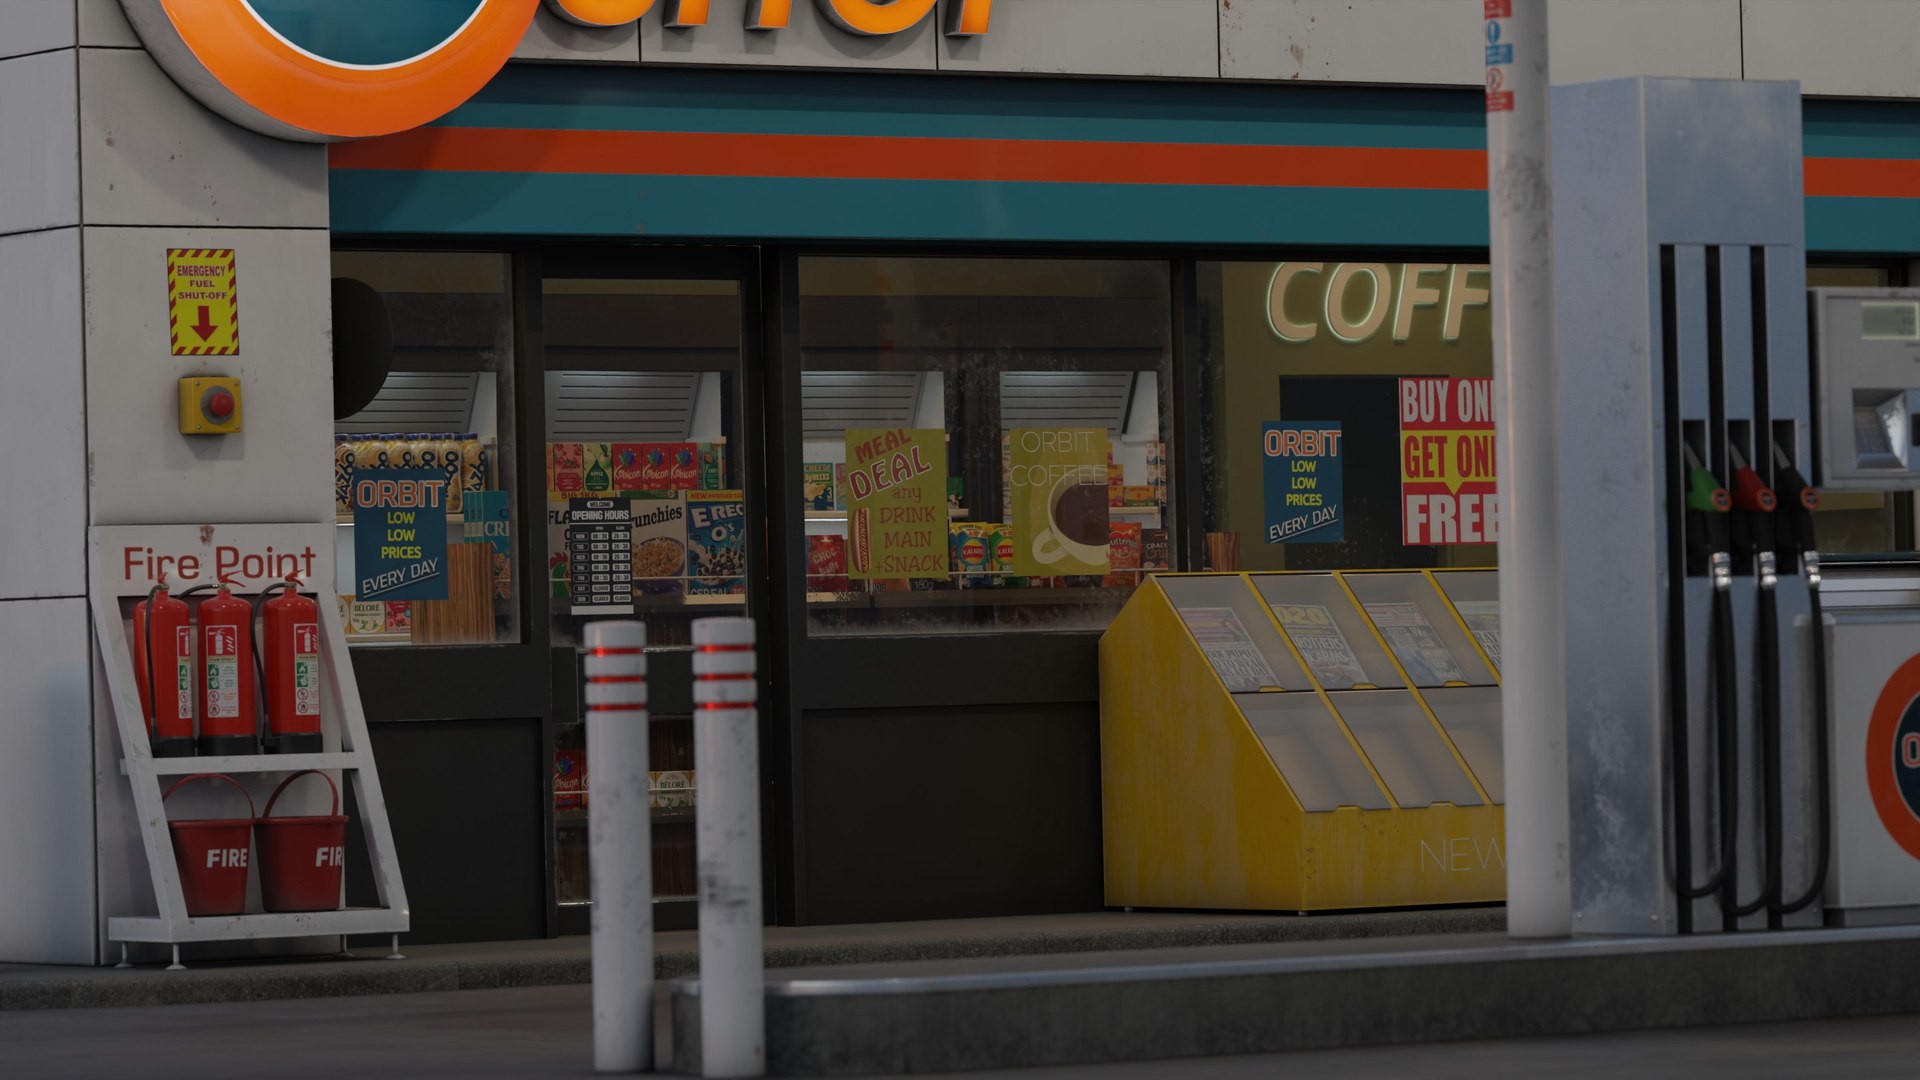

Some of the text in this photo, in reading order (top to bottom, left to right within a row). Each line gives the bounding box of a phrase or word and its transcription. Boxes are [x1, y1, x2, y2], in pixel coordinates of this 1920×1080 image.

[177, 264, 226, 279] EMERGENCY
[189, 280, 215, 289] FUEL
[178, 291, 228, 300] SHUT-OFF
[1402, 379, 1449, 423] BUY
[854, 429, 912, 465] MEAL
[1021, 431, 1094, 454] ORBIT
[1265, 429, 1342, 457] ORBIT
[1405, 435, 1448, 478] GET
[849, 446, 932, 500] DEAL
[1011, 464, 1108, 487] COFFEE
[1291, 460, 1316, 473] LOW
[1291, 477, 1317, 490] LOW
[357, 480, 444, 508] ORBIT
[561, 491, 578, 499] BIG
[892, 486, 922, 503] any
[1285, 493, 1323, 506] PRICES
[387, 511, 415, 524] LOW
[571, 510, 630, 520] OPENING HOURS
[879, 506, 936, 524] DRINK
[1269, 505, 1337, 541] EVERY DAY
[387, 528, 416, 541] LOW
[884, 531, 932, 549] MAIN
[381, 546, 422, 559] PRICES
[124, 546, 316, 580] Fire Point
[874, 554, 944, 573] +SNACK
[362, 557, 438, 594] EVERY DAY
[206, 848, 248, 869] FIRE
